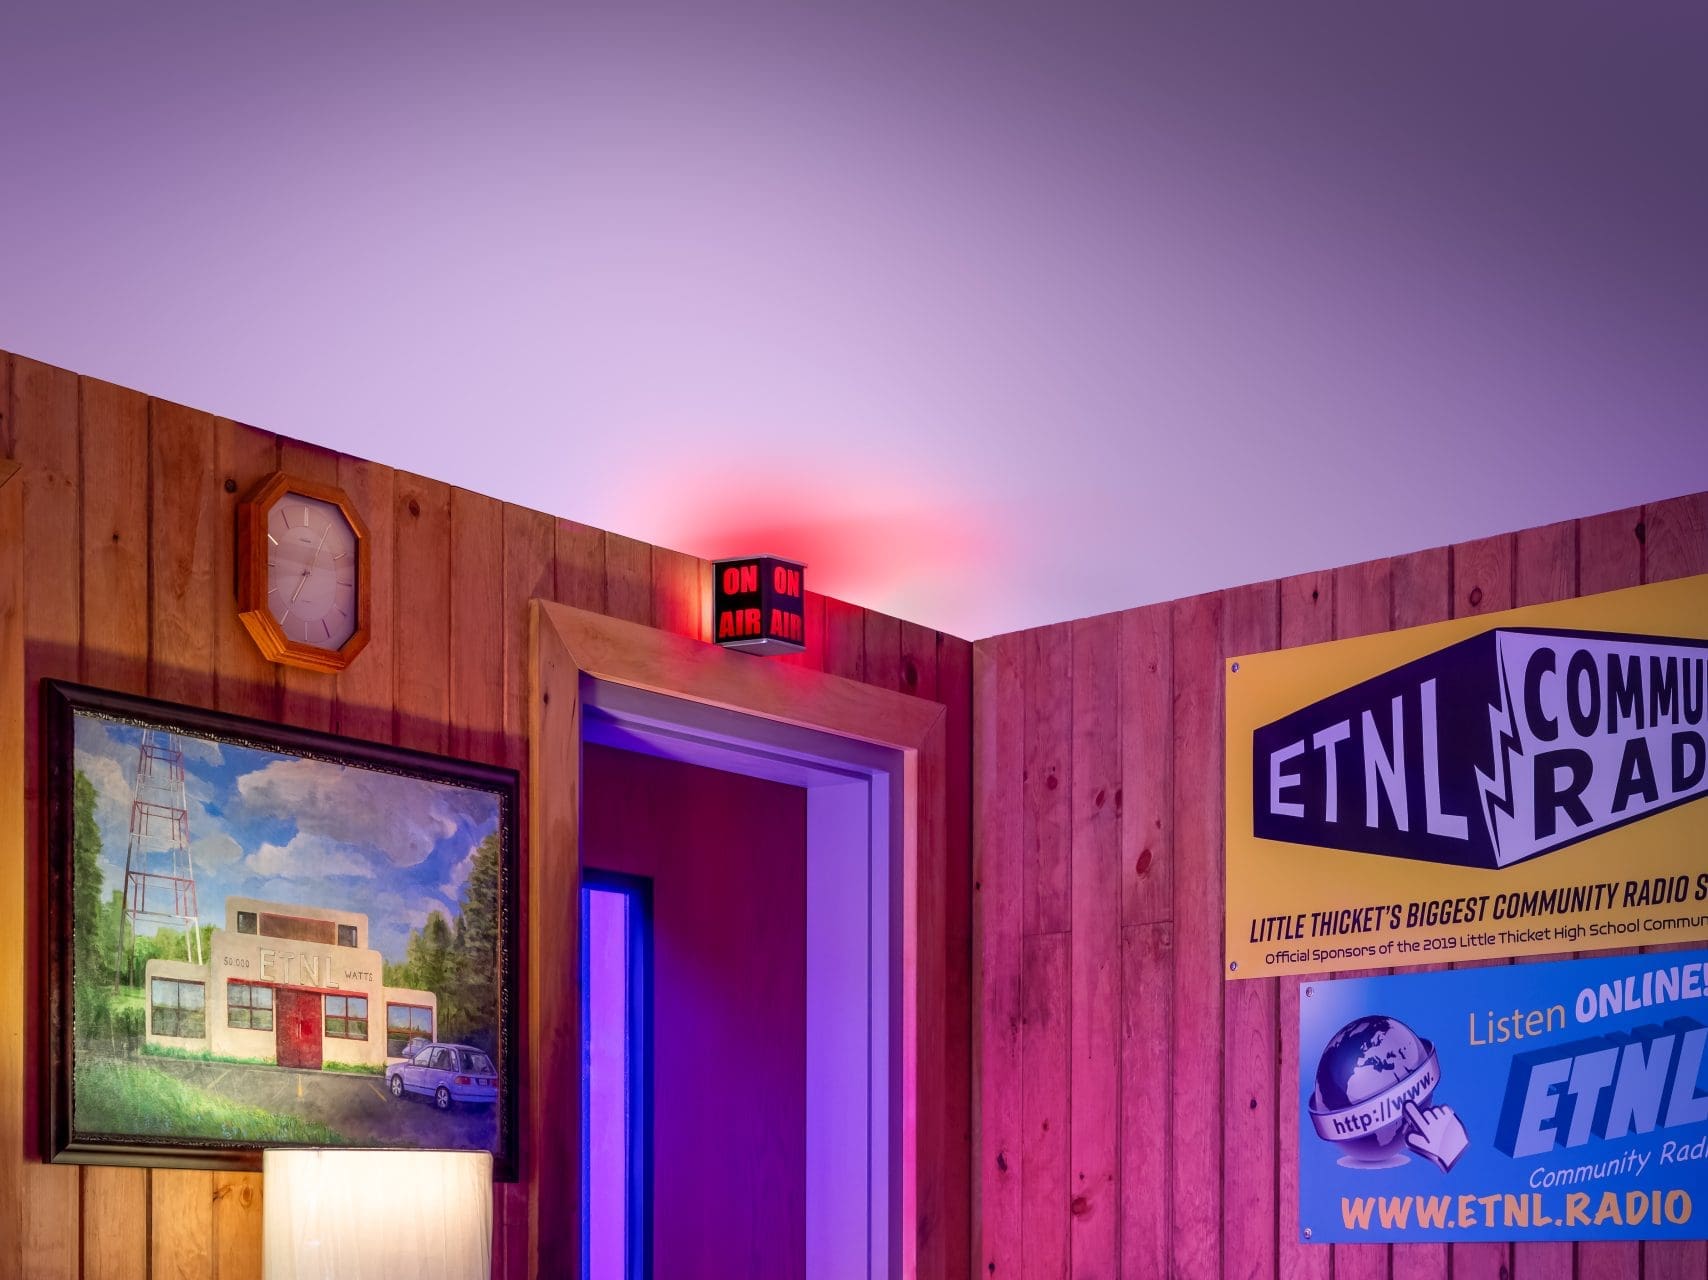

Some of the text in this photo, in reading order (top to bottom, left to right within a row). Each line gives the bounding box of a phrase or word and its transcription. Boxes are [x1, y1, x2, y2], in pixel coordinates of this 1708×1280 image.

[723, 565, 758, 595] ON
[774, 566, 800, 598] ON
[719, 608, 761, 639] AIR
[770, 608, 802, 640] AIR
[1523, 646, 1708, 742] COMMU
[1270, 677, 1469, 841] ETNL
[1533, 730, 1706, 841] RAD
[1249, 914, 1307, 943] LITTLE
[1311, 904, 1403, 938] THICKET'S
[1406, 896, 1490, 928] BIGGEST
[1492, 882, 1620, 920] COMMUNITY
[1622, 875, 1690, 908] RADIO
[1265, 948, 1310, 965] Official
[1312, 945, 1376, 964] Sponsors
[1378, 940, 1394, 955] of
[1396, 939, 1421, 953] the
[1423, 936, 1457, 952] 2019
[1460, 932, 1496, 948] Little
[1498, 927, 1552, 945] Thicket
[1554, 924, 1586, 942] High
[1589, 918, 1640, 937] School
[260, 947, 340, 989] ETNL
[344, 969, 374, 983] WATTS
[1469, 1003, 1566, 1047] Listen
[1512, 1026, 1708, 1160] ETNL
[1529, 1135, 1708, 1190] Community Rad
[1341, 1189, 1692, 1231] WWW.ETNL.RADIO
